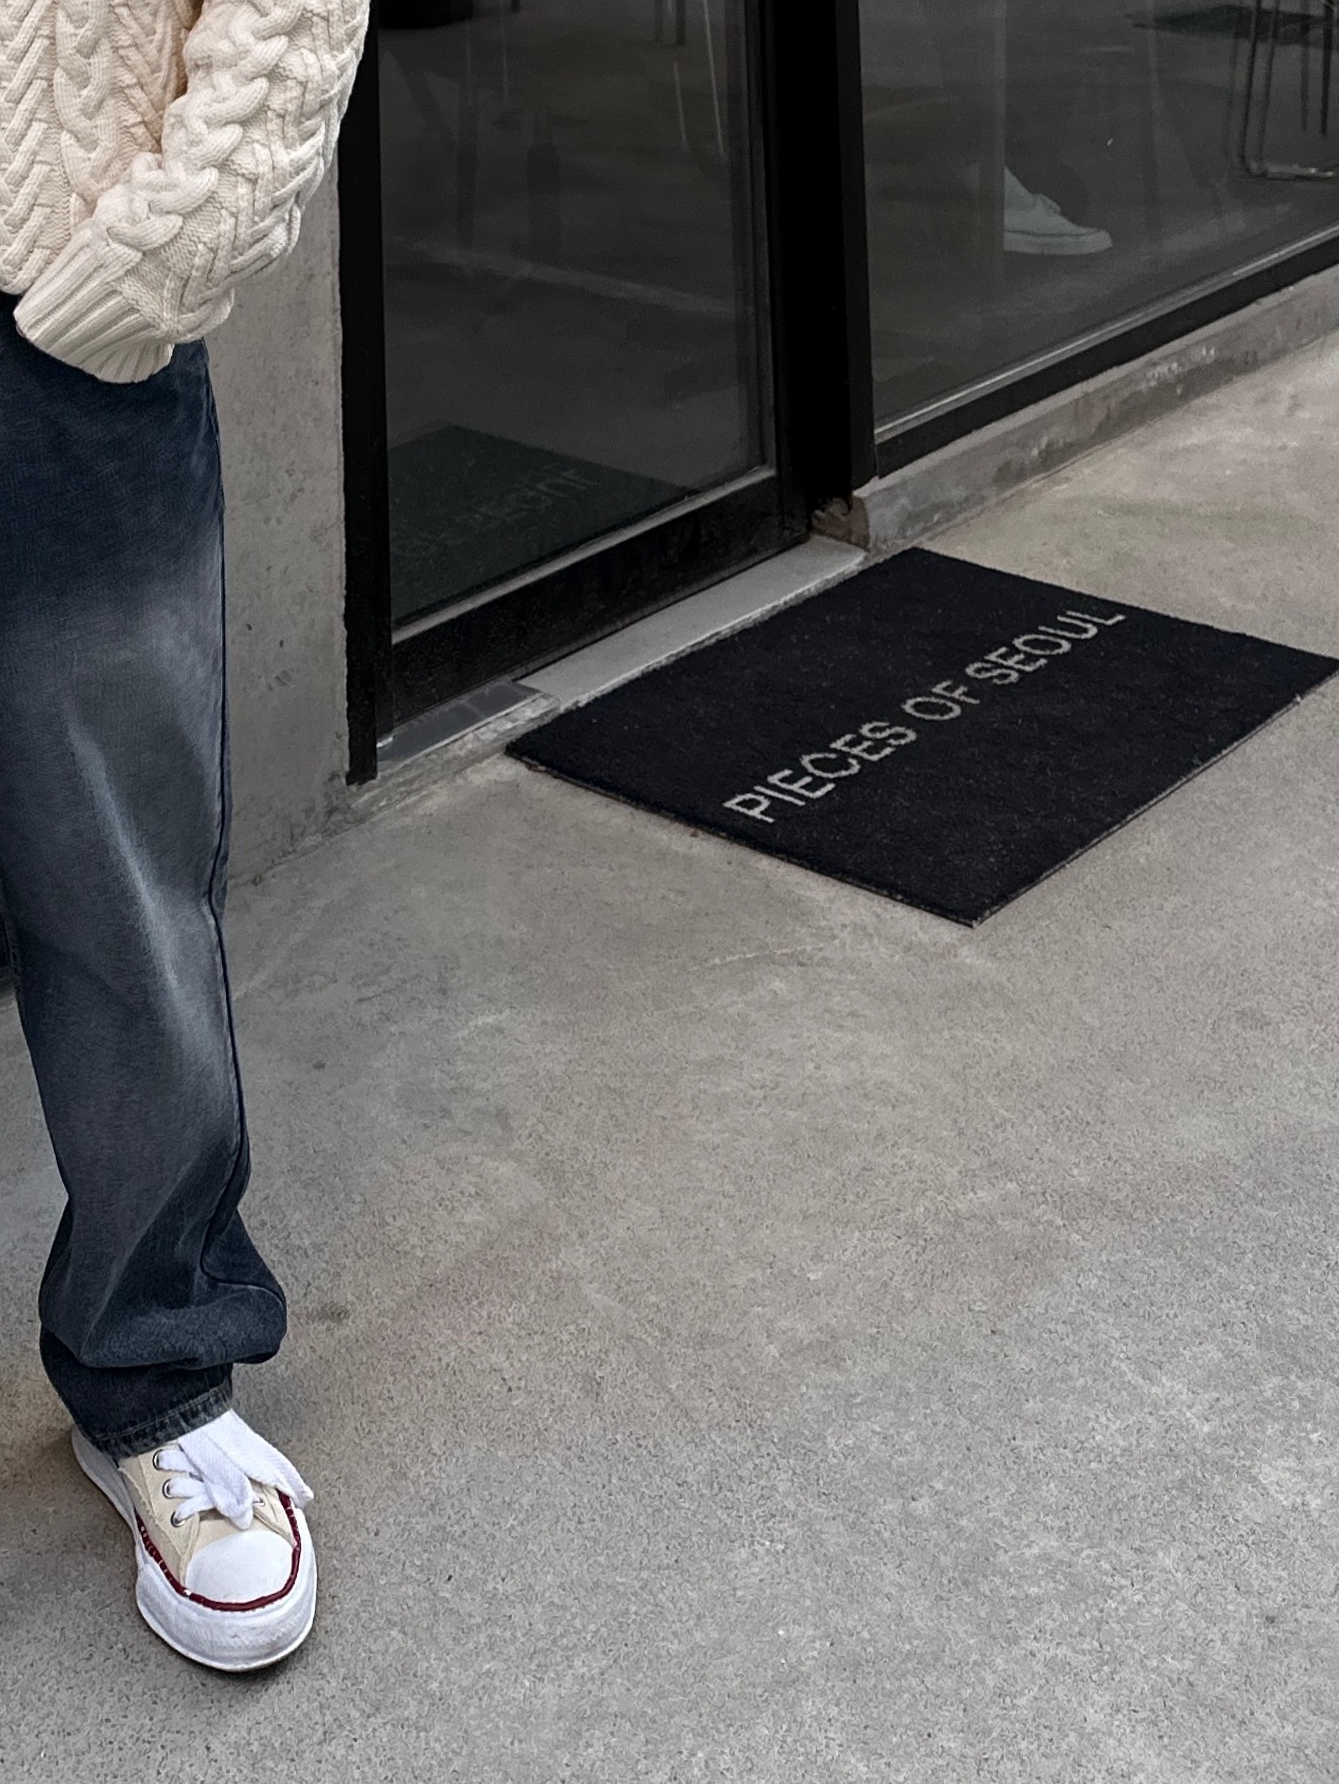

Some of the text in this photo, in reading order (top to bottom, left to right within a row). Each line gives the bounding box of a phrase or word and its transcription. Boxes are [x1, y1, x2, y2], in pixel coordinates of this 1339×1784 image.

[723, 610, 1126, 823] PIECES OF SEOUL
